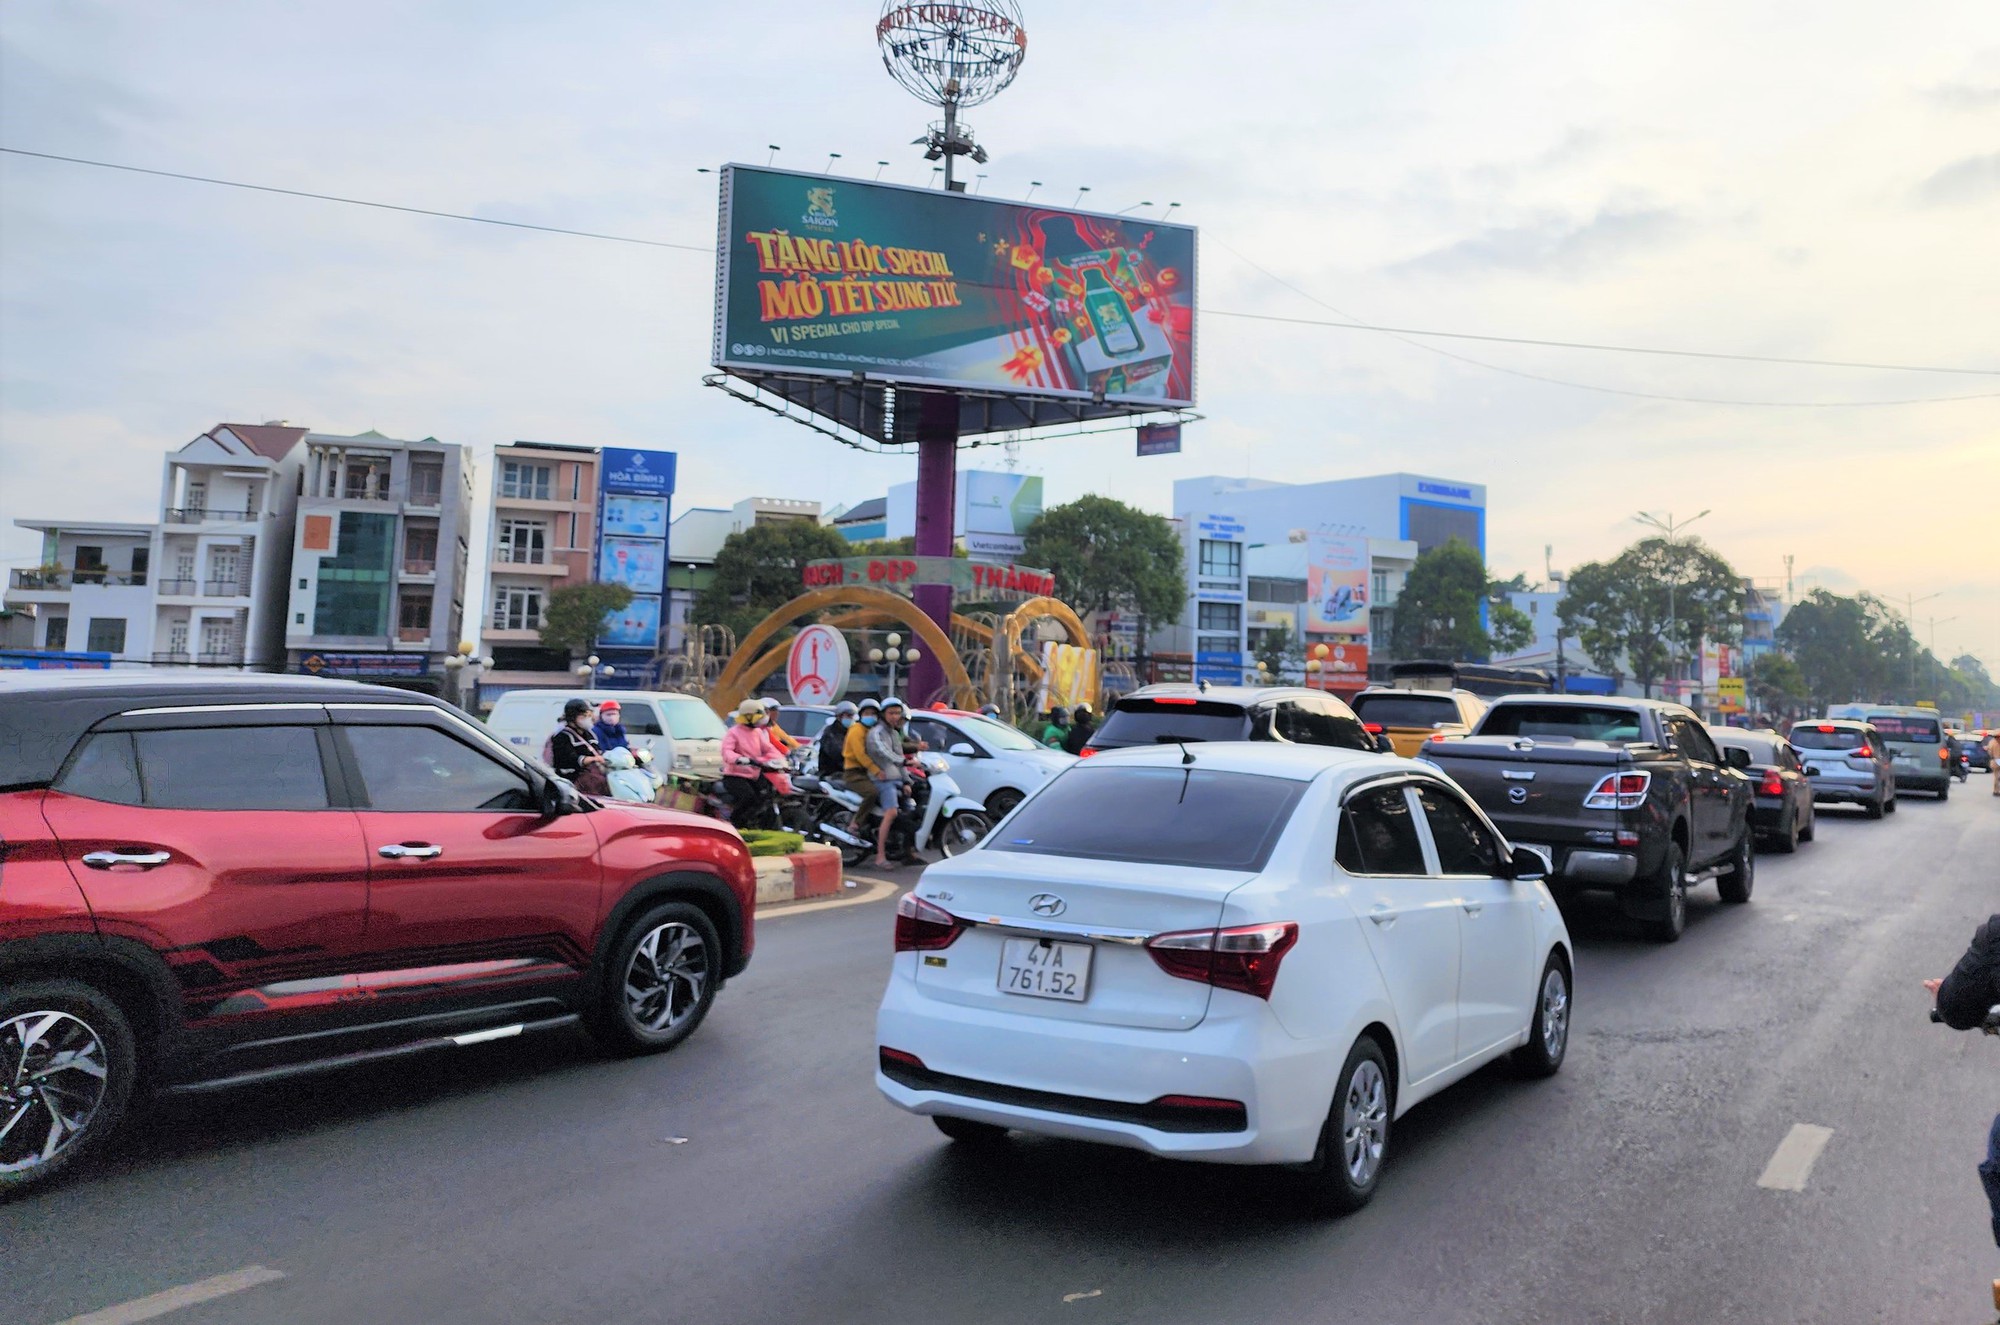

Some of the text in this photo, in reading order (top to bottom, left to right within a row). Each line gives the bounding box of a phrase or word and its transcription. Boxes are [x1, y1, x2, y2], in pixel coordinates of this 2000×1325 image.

[801, 215, 839, 227] SAIGON
[746, 228, 954, 278] TẶNG LỘC SPECIAL
[757, 271, 824, 321] MỞ
[820, 273, 876, 316] TẾT
[872, 280, 933, 312] SUNG
[770, 327, 789, 344] VỊ
[791, 322, 843, 341] SPECIAL
[841, 320, 861, 335] CHO
[875, 319, 900, 331] SPECIAL
[1028, 944, 1063, 967] 47A
[1010, 966, 1077, 995] 761.52
